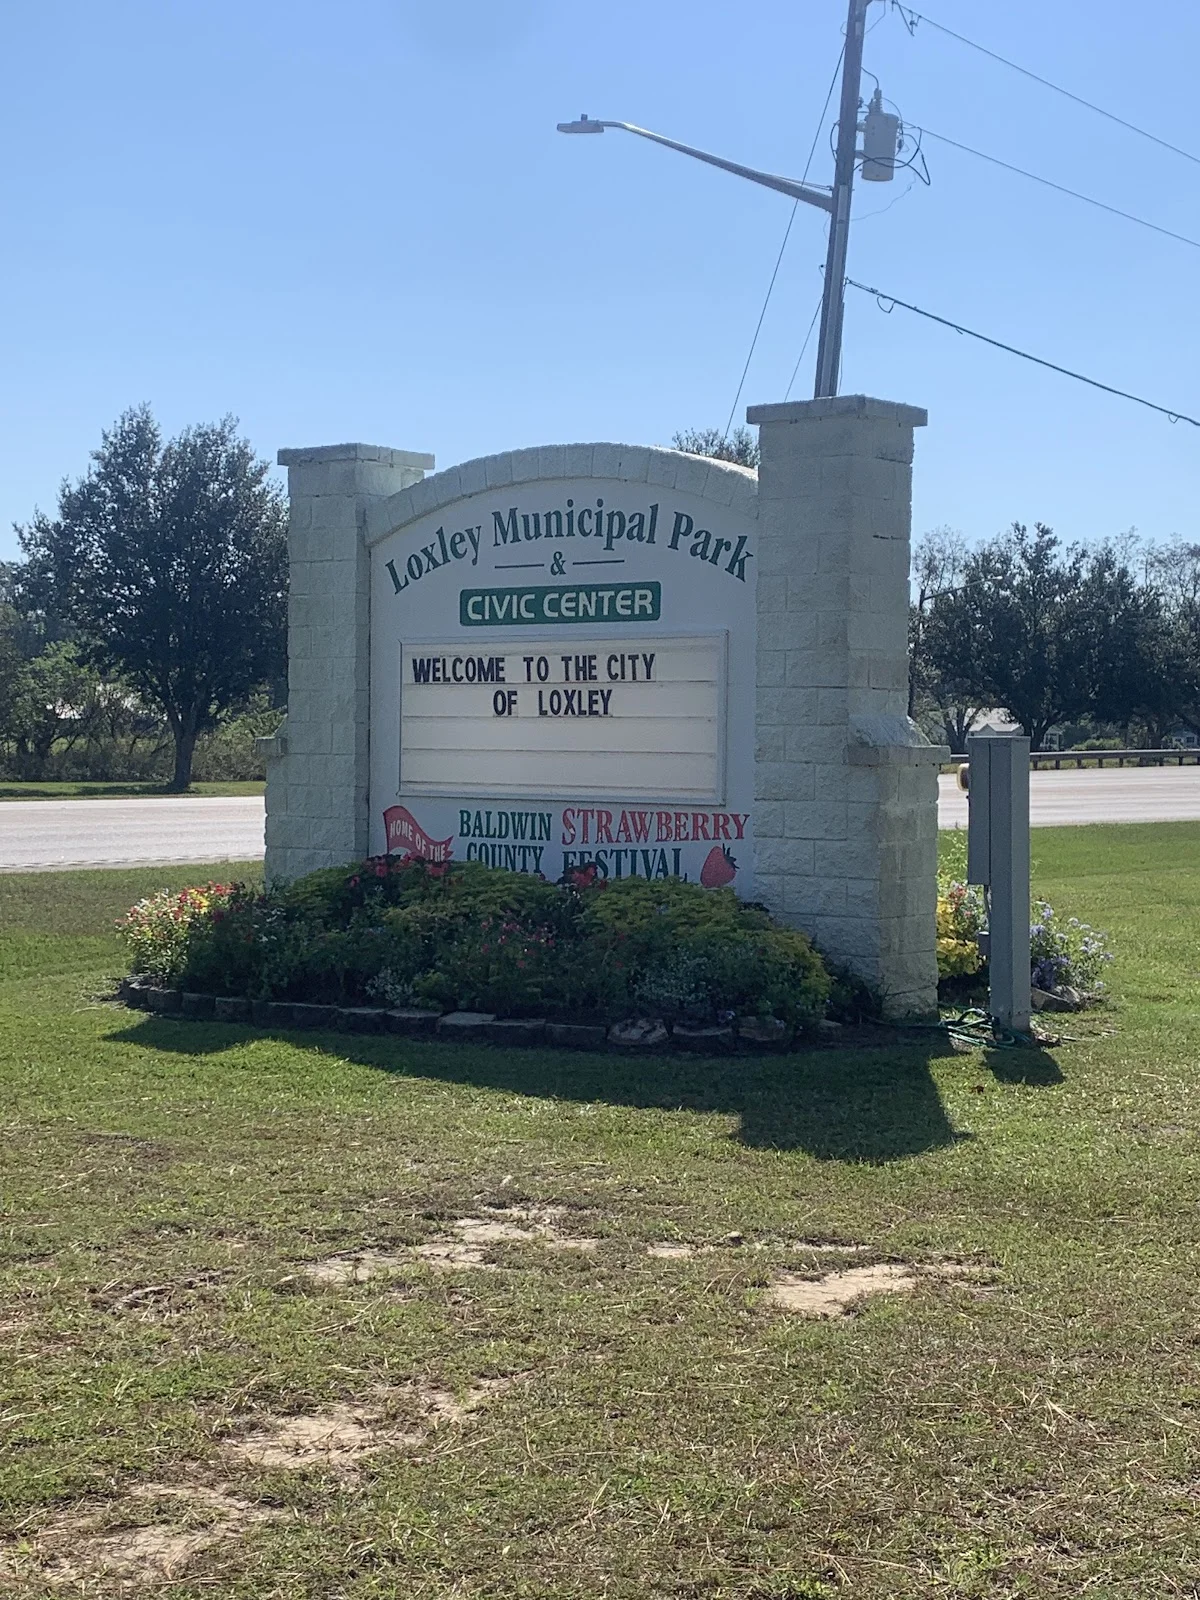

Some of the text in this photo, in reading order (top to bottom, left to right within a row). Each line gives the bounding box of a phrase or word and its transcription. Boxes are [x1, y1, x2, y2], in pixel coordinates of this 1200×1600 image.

[385, 499, 754, 595] Loxley Municipal Park
[549, 551, 567, 576] &
[467, 588, 653, 620] CIVIC CENTER
[412, 653, 656, 683] WELCOME TO THE CITY
[493, 689, 613, 716] OF LOXLEY
[389, 819, 446, 862] HOME OF THE
[459, 808, 751, 845] BALDWIN STRAWBERRY
[466, 842, 544, 874] COUNTY
